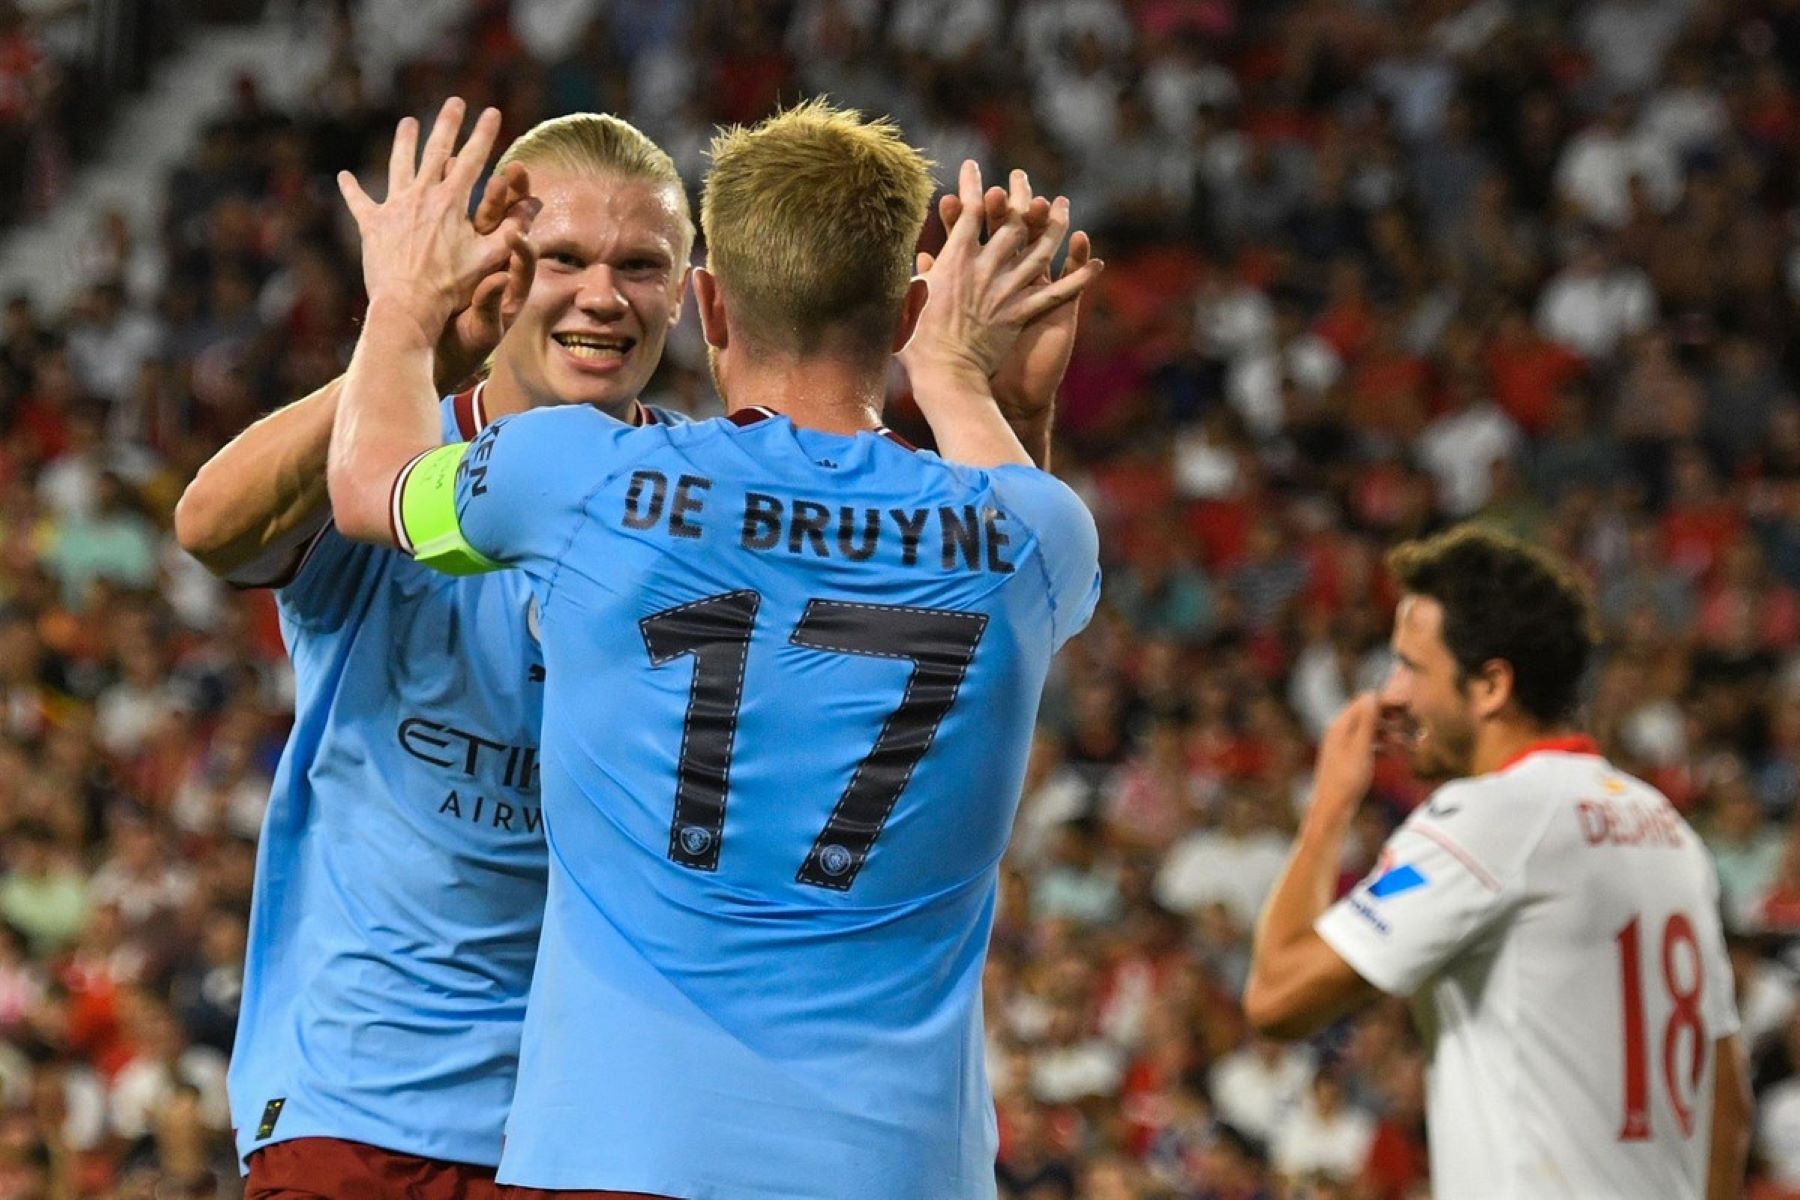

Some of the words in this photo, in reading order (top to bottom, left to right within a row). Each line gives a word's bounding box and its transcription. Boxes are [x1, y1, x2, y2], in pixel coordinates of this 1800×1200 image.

[621, 469, 712, 538] DE
[740, 491, 1016, 574] BRUYNE
[639, 589, 990, 891] 17
[1614, 911, 1706, 1143] 18
